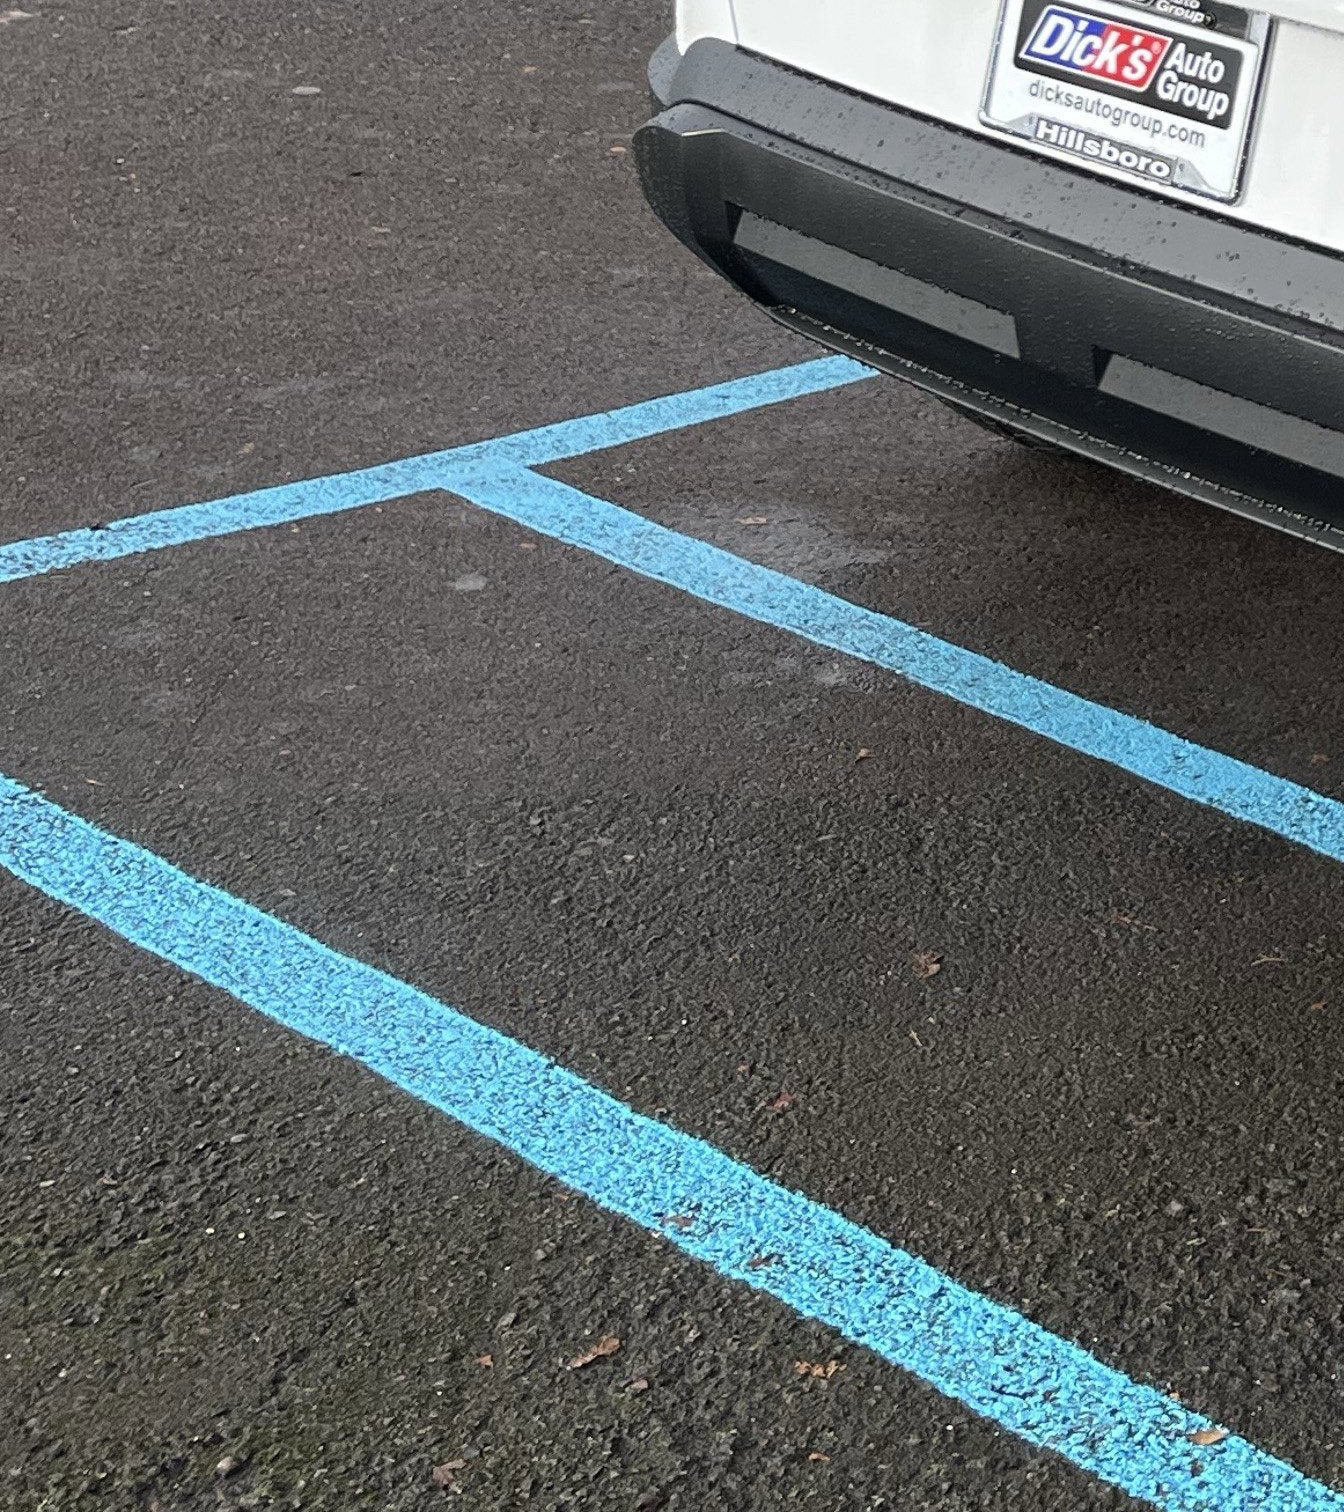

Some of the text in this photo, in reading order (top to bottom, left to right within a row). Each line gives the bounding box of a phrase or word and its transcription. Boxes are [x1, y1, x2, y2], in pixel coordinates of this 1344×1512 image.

[1155, 0, 1206, 24] Group
[1029, 13, 1153, 81] Dick's
[1163, 42, 1226, 84] Auto
[1028, 79, 1206, 149] dicksautogroup.com
[1155, 70, 1230, 121] Group
[1035, 118, 1172, 178] Hillsboro
